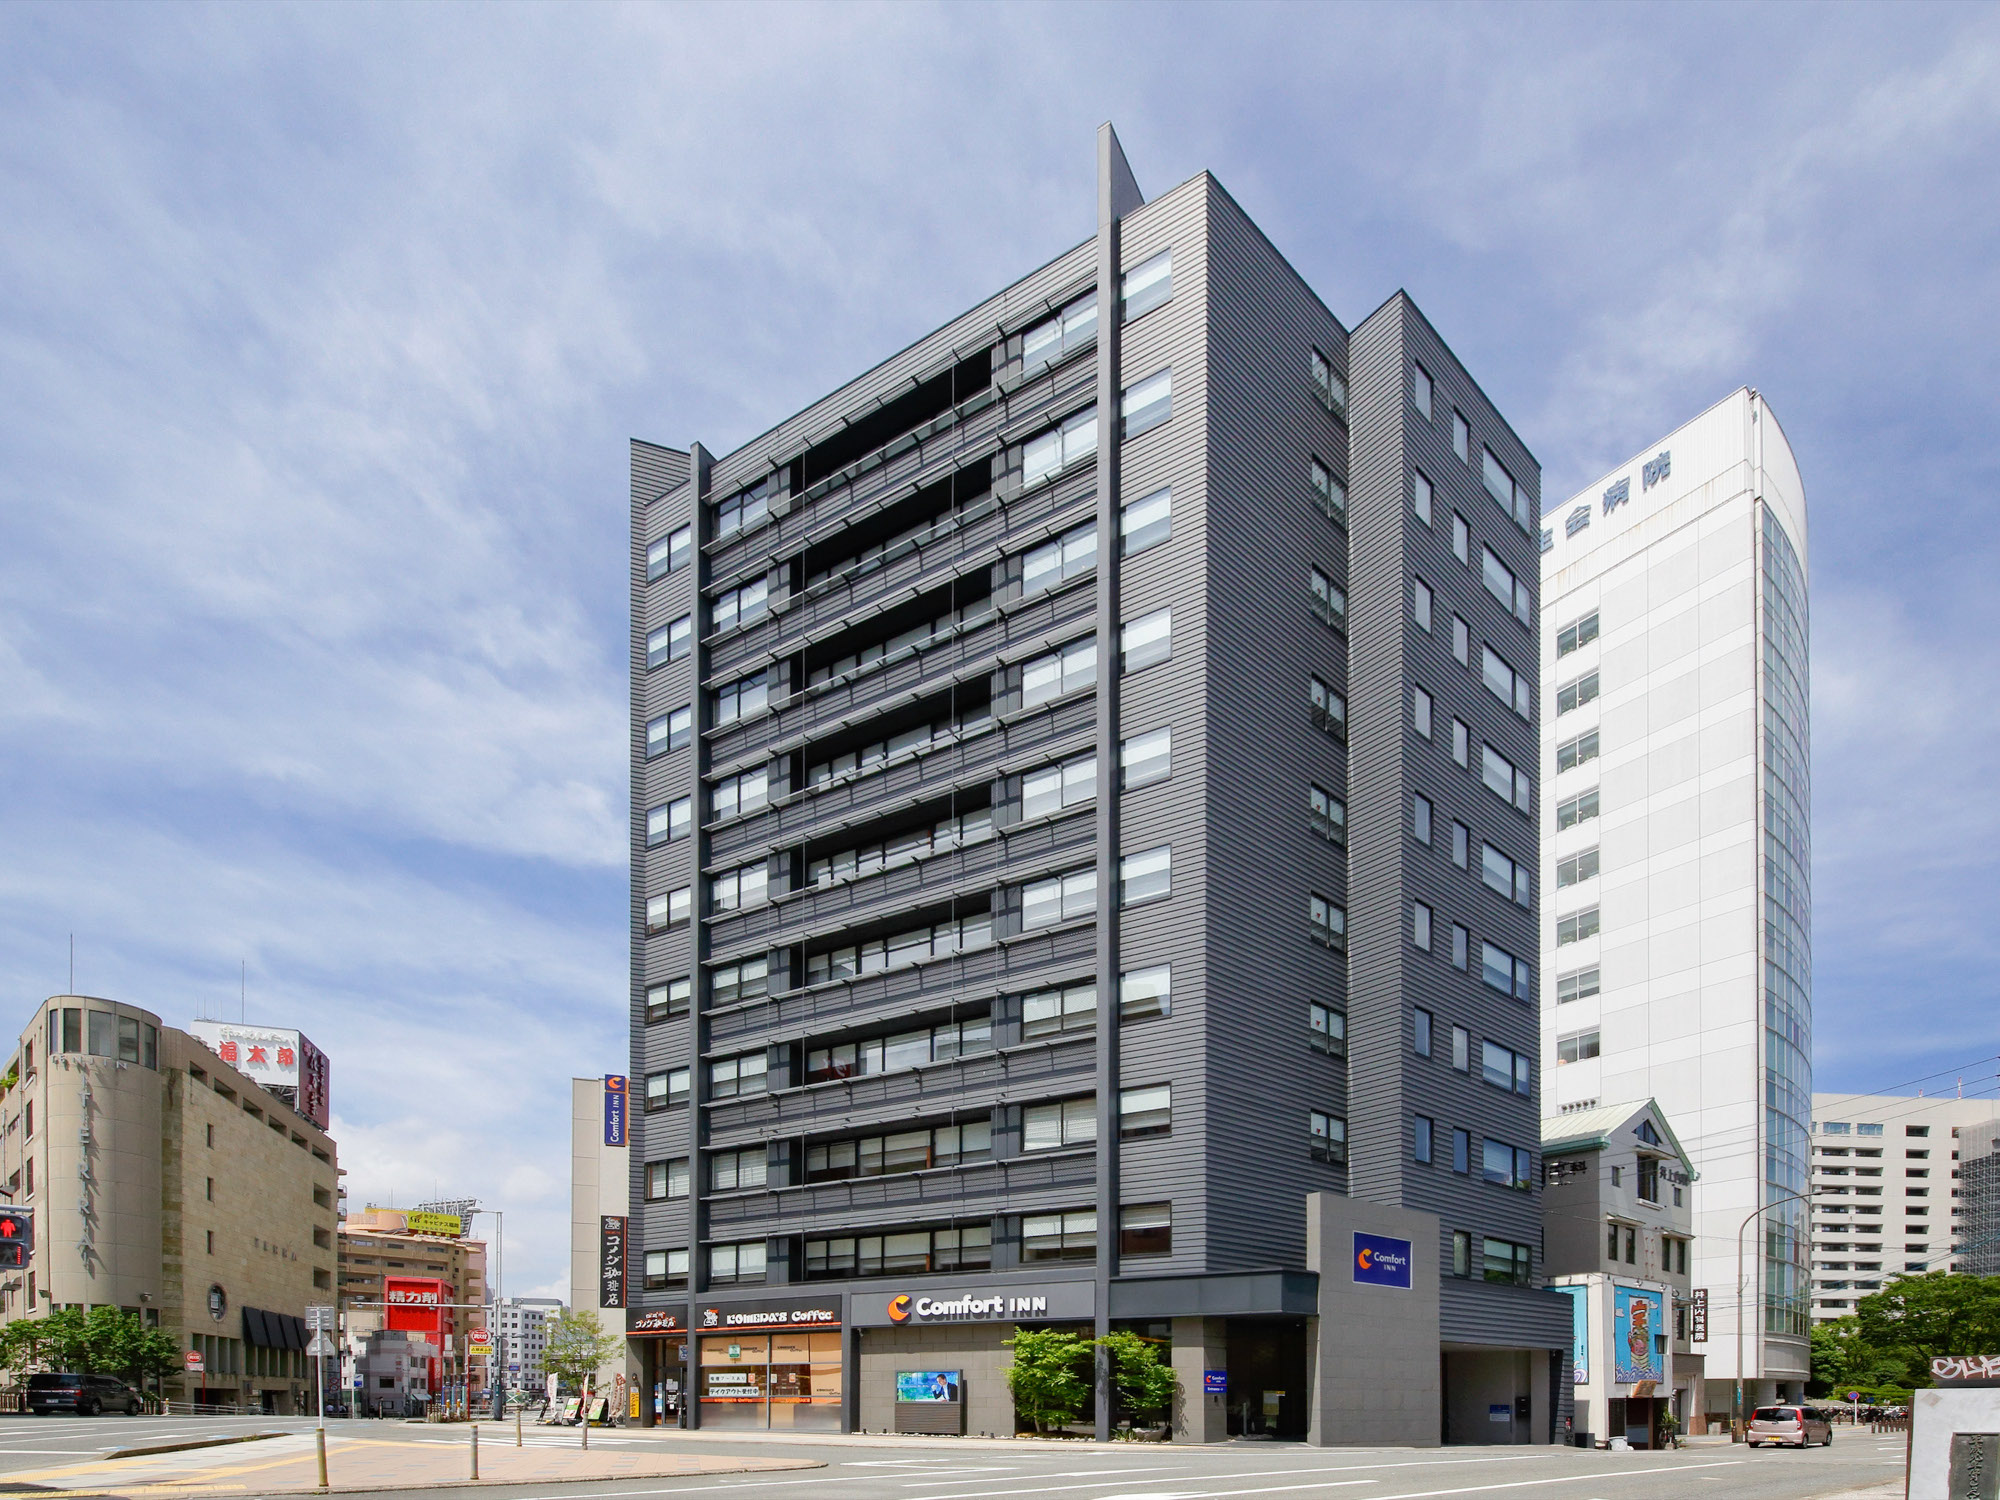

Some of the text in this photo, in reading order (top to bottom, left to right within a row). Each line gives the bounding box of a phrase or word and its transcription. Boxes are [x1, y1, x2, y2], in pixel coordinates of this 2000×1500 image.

[219, 1040, 294, 1066] 福太郎
[52, 1055, 127, 1070] TENJIN
[610, 1110, 619, 1142] Comfort
[75, 1091, 94, 1250] TERRA
[1374, 1251, 1406, 1265] Comfort
[1384, 1263, 1396, 1271] INN
[603, 1235, 622, 1306] コメダ珈琲店
[389, 1290, 438, 1304] 精力剤
[916, 1294, 1046, 1316] Comfort INN
[727, 1310, 833, 1325] KOMEDA'S Coffee
